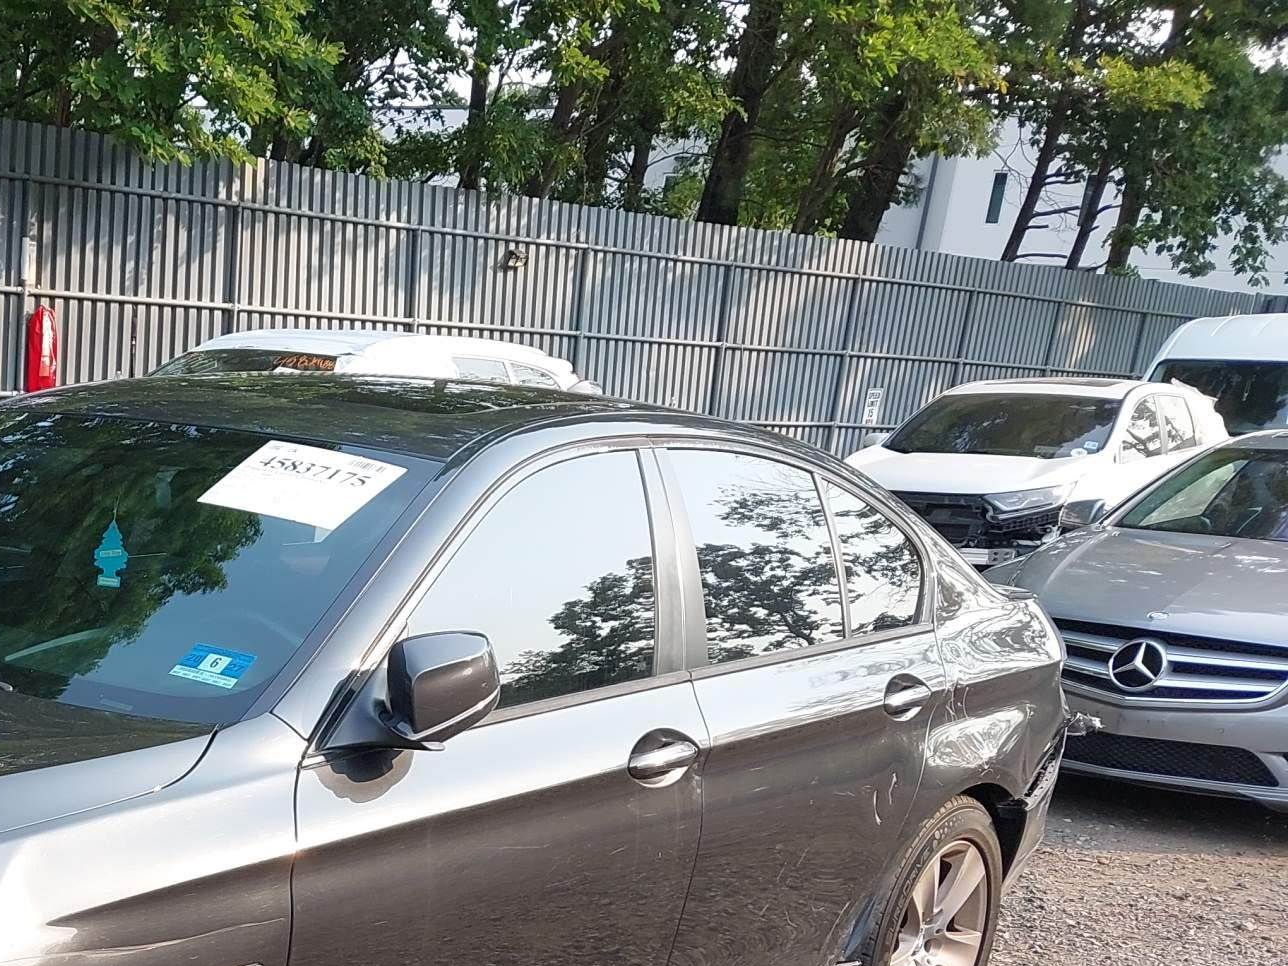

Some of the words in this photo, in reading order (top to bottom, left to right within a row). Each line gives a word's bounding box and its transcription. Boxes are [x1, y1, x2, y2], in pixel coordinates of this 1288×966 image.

[867, 400, 879, 408] LIMIT
[259, 455, 372, 488] 45837175
[209, 657, 222, 668] 6
